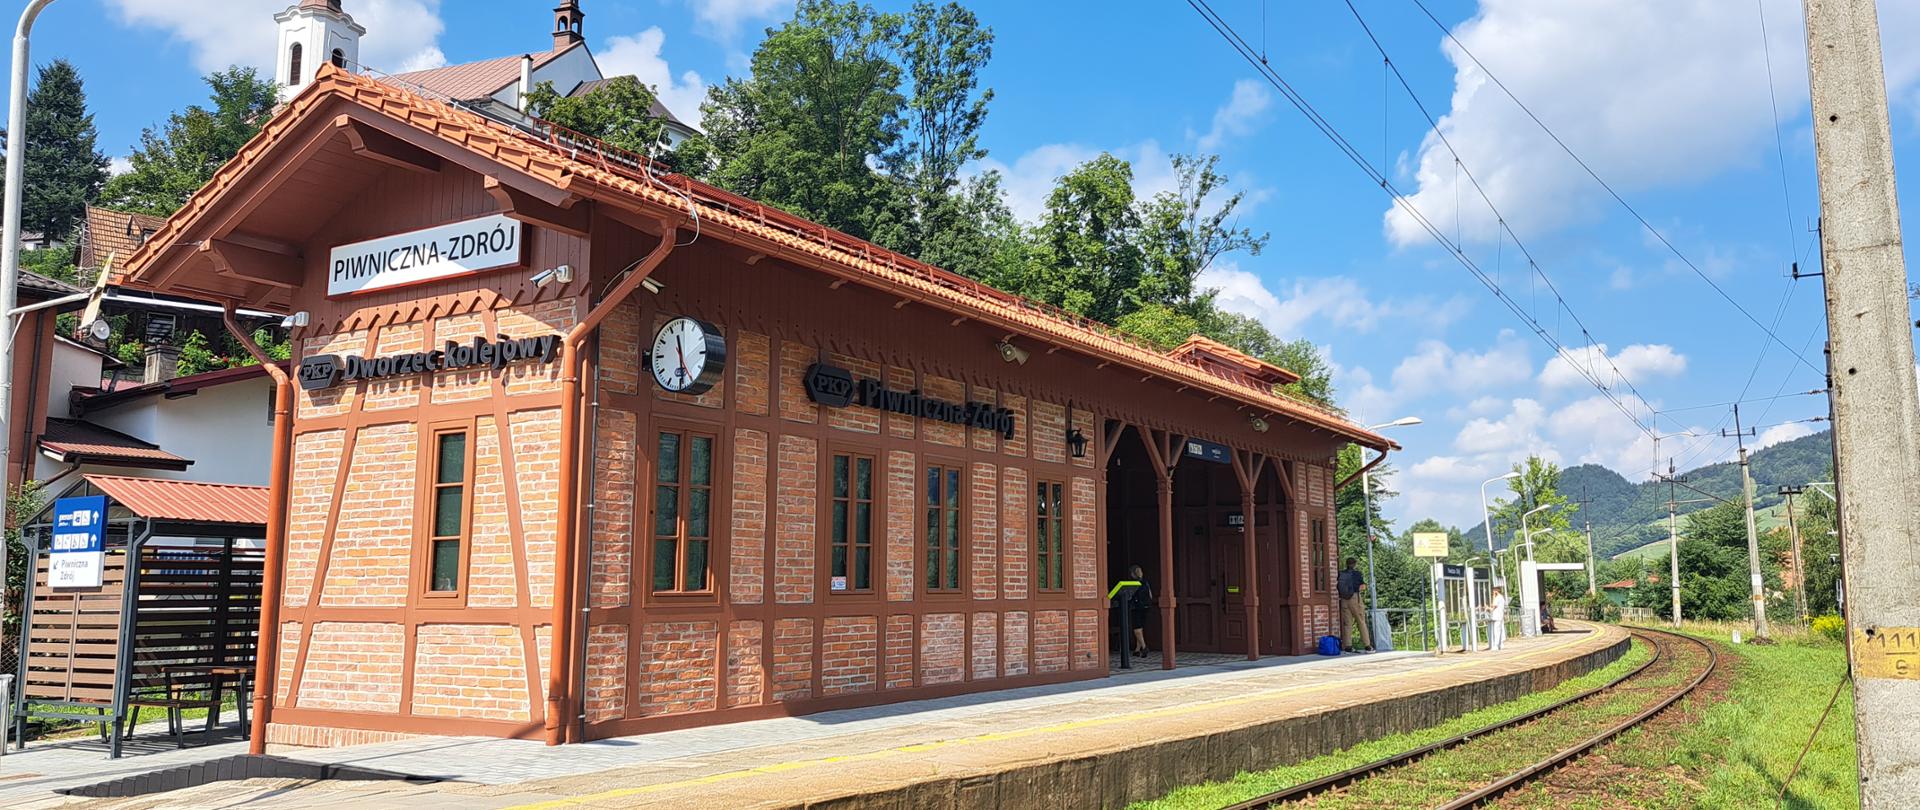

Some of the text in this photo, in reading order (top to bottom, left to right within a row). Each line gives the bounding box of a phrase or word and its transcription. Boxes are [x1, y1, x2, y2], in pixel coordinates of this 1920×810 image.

[333, 224, 515, 282] PIWNICZNA-ZDRÓJ
[302, 333, 559, 380] PKP Dworzec kolejowy
[816, 375, 850, 396] PKP
